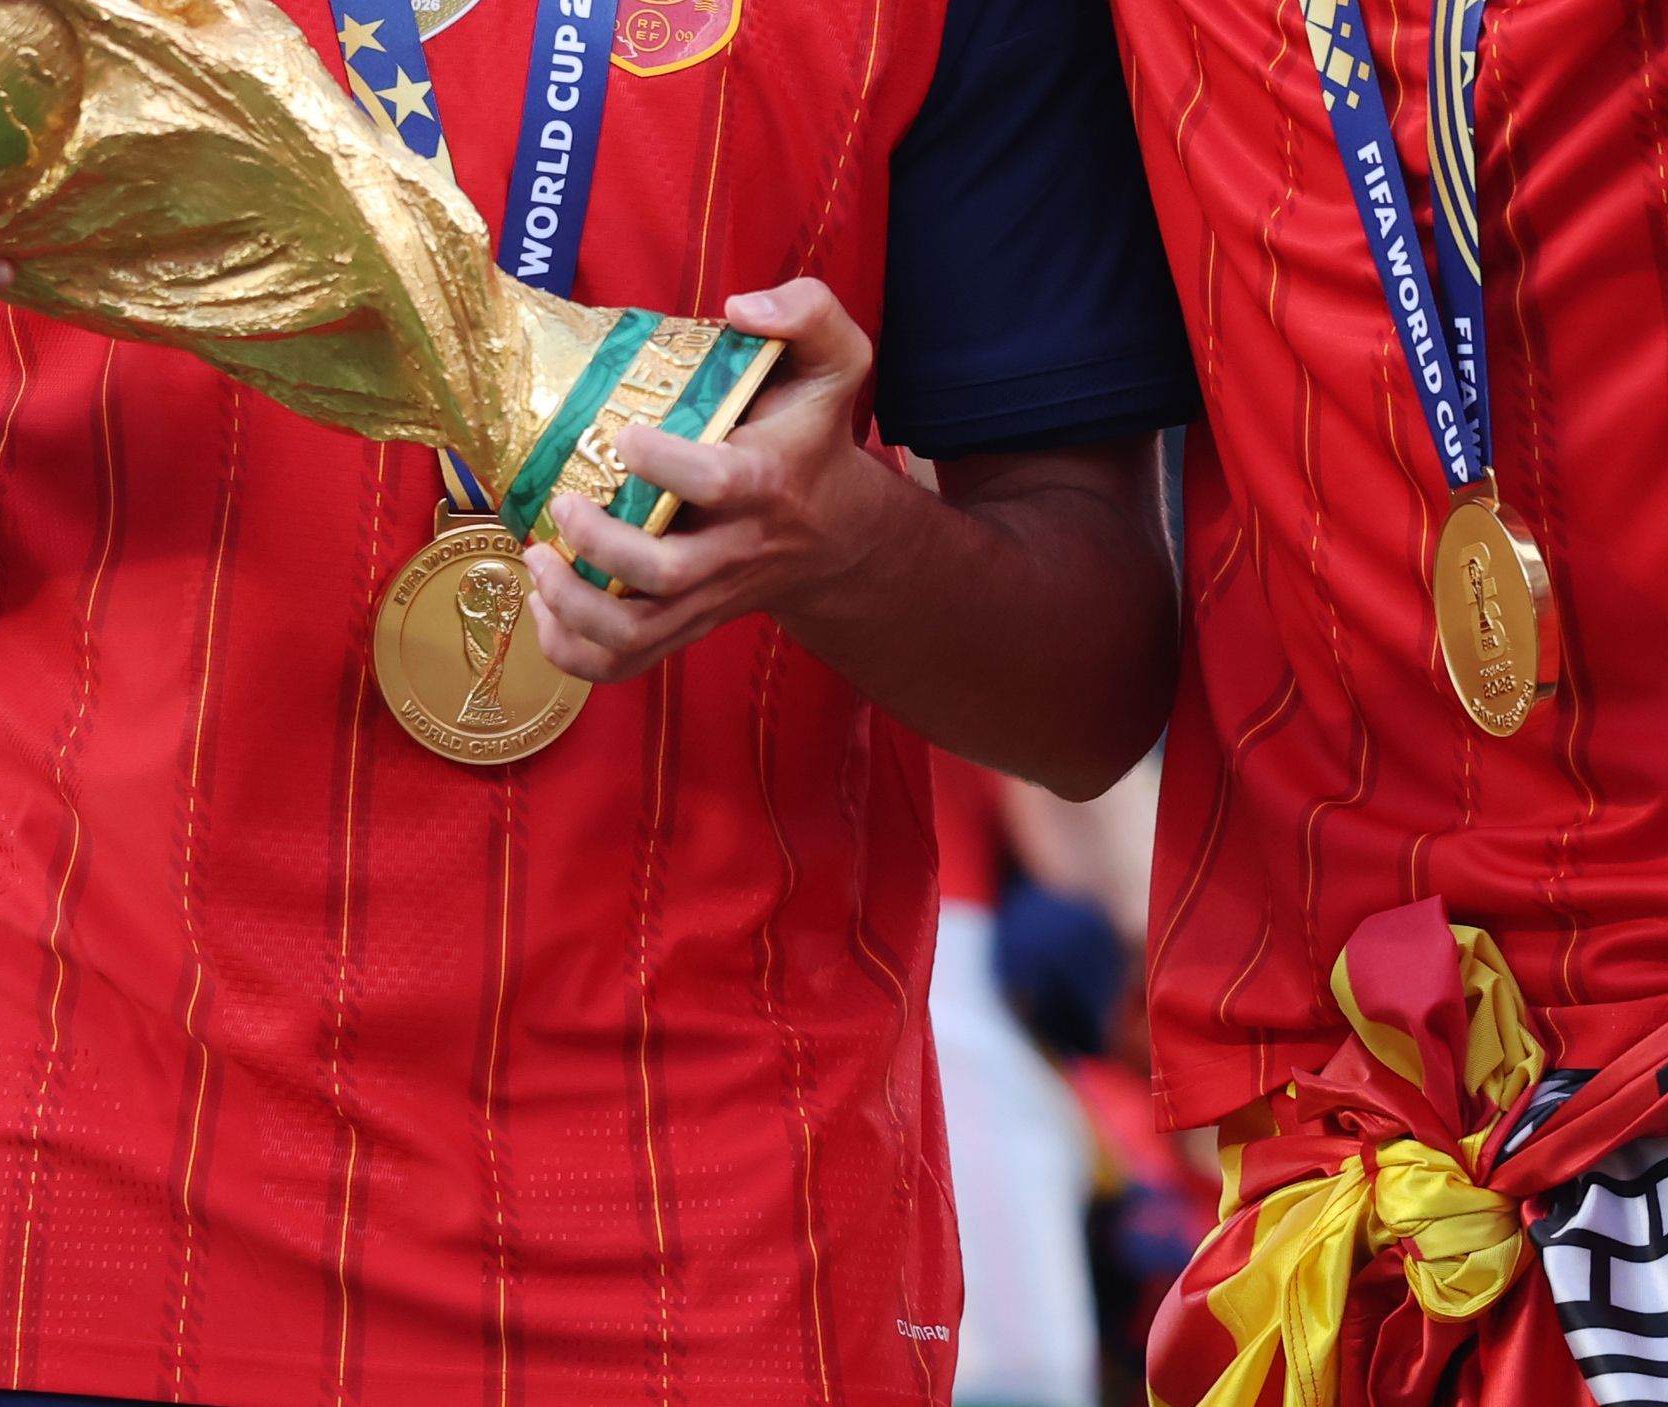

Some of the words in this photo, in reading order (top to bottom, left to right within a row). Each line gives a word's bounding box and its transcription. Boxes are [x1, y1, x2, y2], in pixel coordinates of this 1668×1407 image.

[517, 120, 573, 277] WORLD
[546, 24, 586, 112] CUP
[1357, 140, 1397, 239] FIFA
[1387, 235, 1442, 395] WORLD
[1436, 400, 1469, 484] CUP
[1454, 317, 1478, 411] FIFA
[394, 566, 427, 606] FIFA
[422, 534, 489, 571] WORLD
[401, 699, 463, 751] WORLD
[468, 698, 571, 755] CHAMPION
